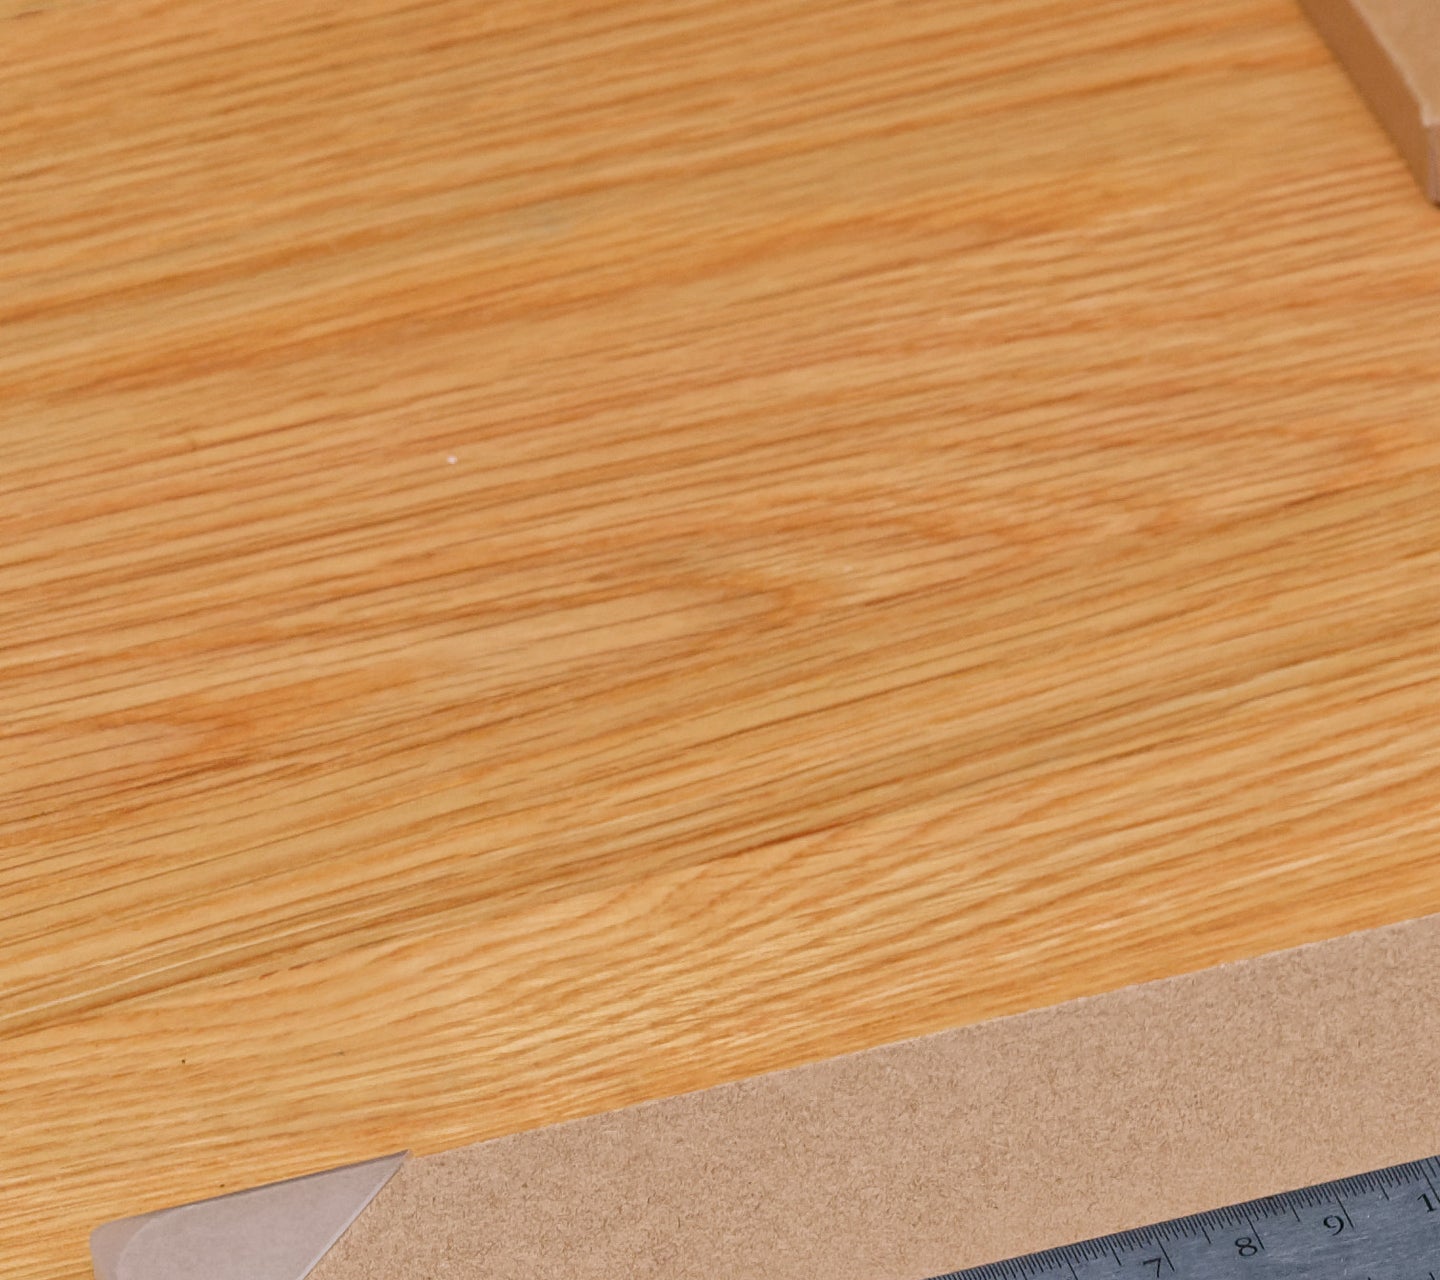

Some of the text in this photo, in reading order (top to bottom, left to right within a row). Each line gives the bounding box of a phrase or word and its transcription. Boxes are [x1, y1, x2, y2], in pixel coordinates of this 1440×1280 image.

[1142, 1257, 1164, 1280] 7
[1234, 1235, 1259, 1258] 8
[1322, 1214, 1346, 1237] 9
